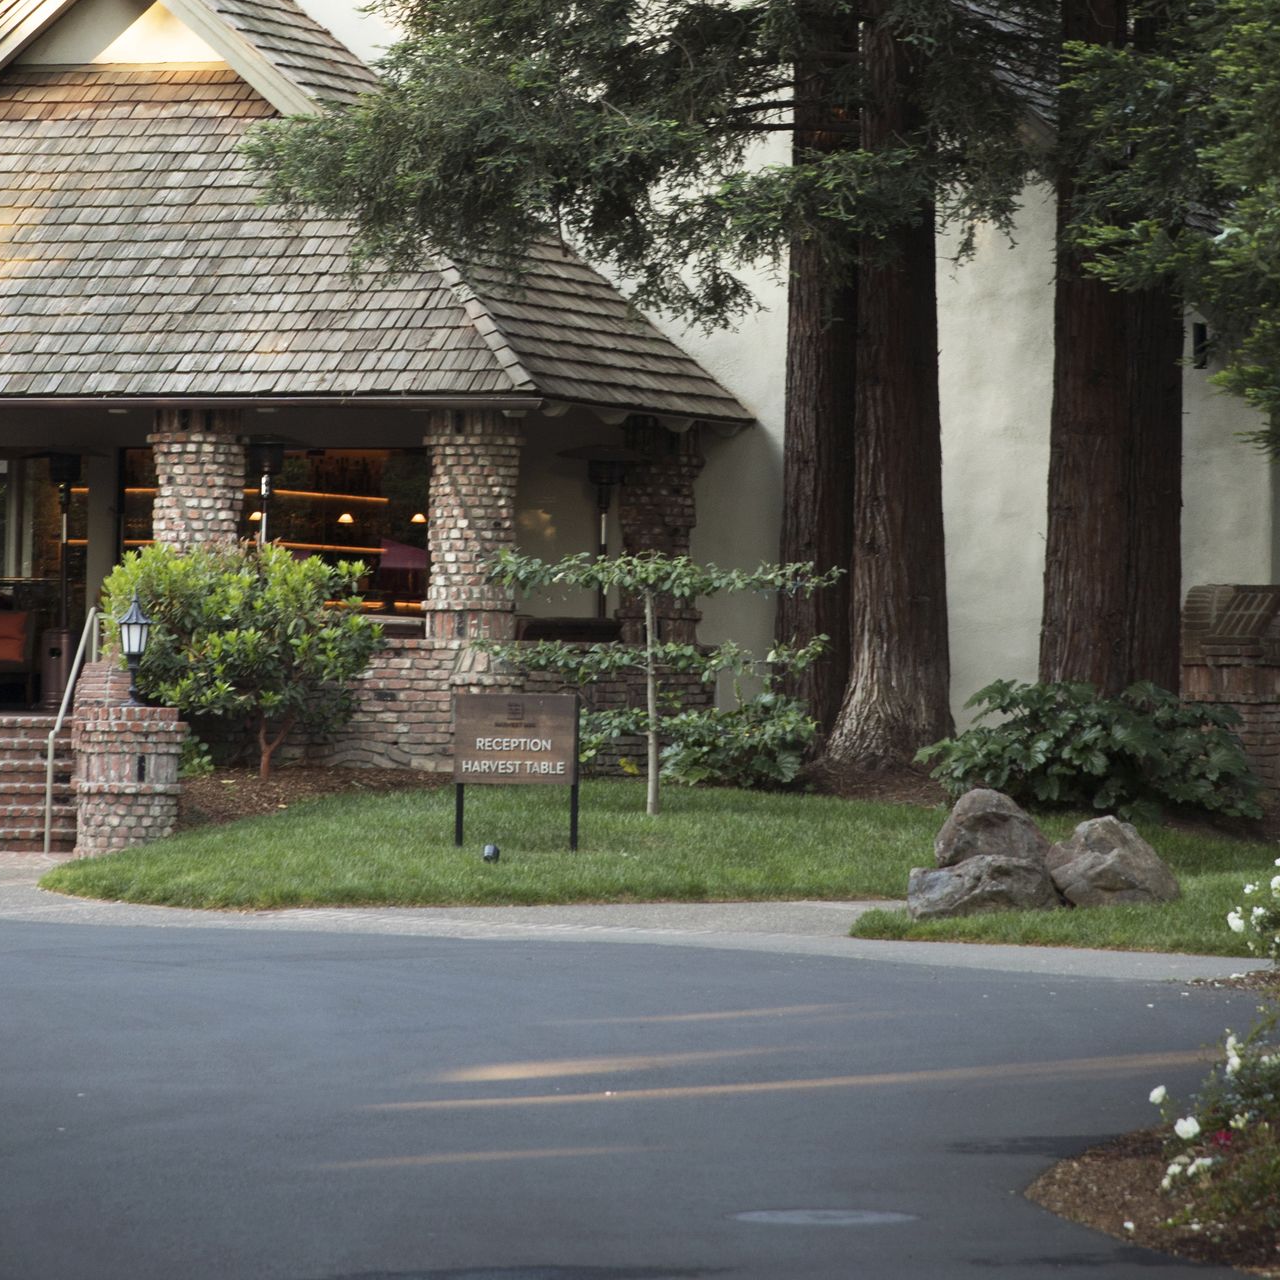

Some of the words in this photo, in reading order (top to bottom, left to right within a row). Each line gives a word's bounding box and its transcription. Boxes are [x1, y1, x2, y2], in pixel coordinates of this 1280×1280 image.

[475, 737, 552, 751] RECEPTION
[462, 760, 522, 773] HARVEST
[524, 761, 566, 774] TABLE
